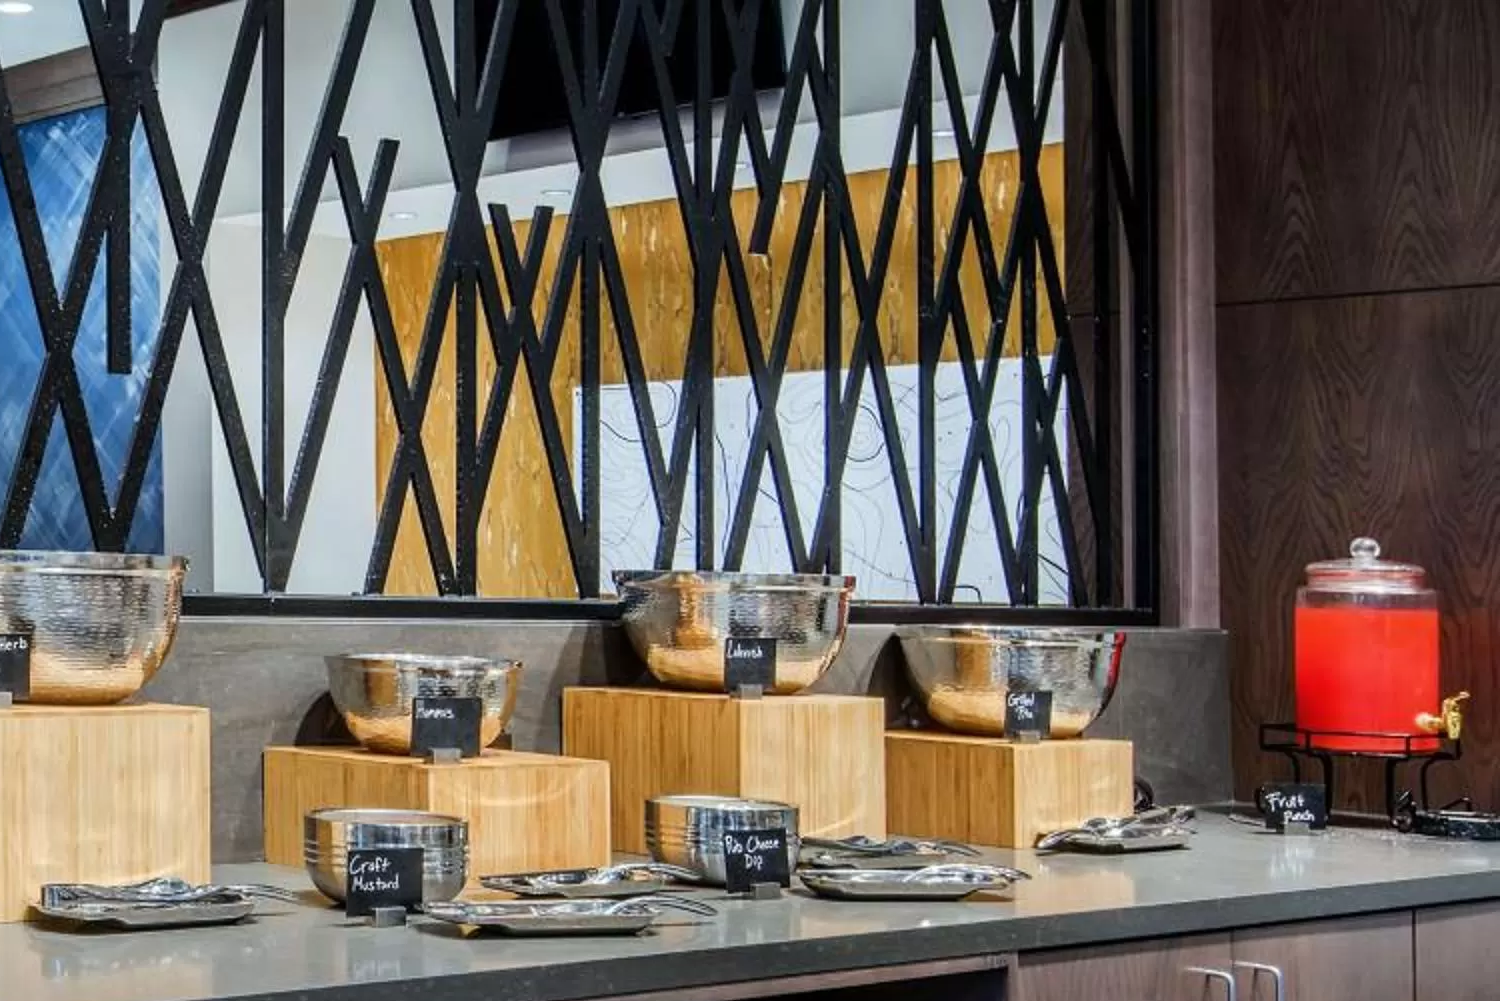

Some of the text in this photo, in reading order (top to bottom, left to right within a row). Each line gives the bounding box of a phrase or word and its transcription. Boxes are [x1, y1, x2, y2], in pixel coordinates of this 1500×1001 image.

[1265, 791, 1305, 812] Fruit
[349, 854, 392, 875] Craft
[352, 872, 399, 892] Mustard
